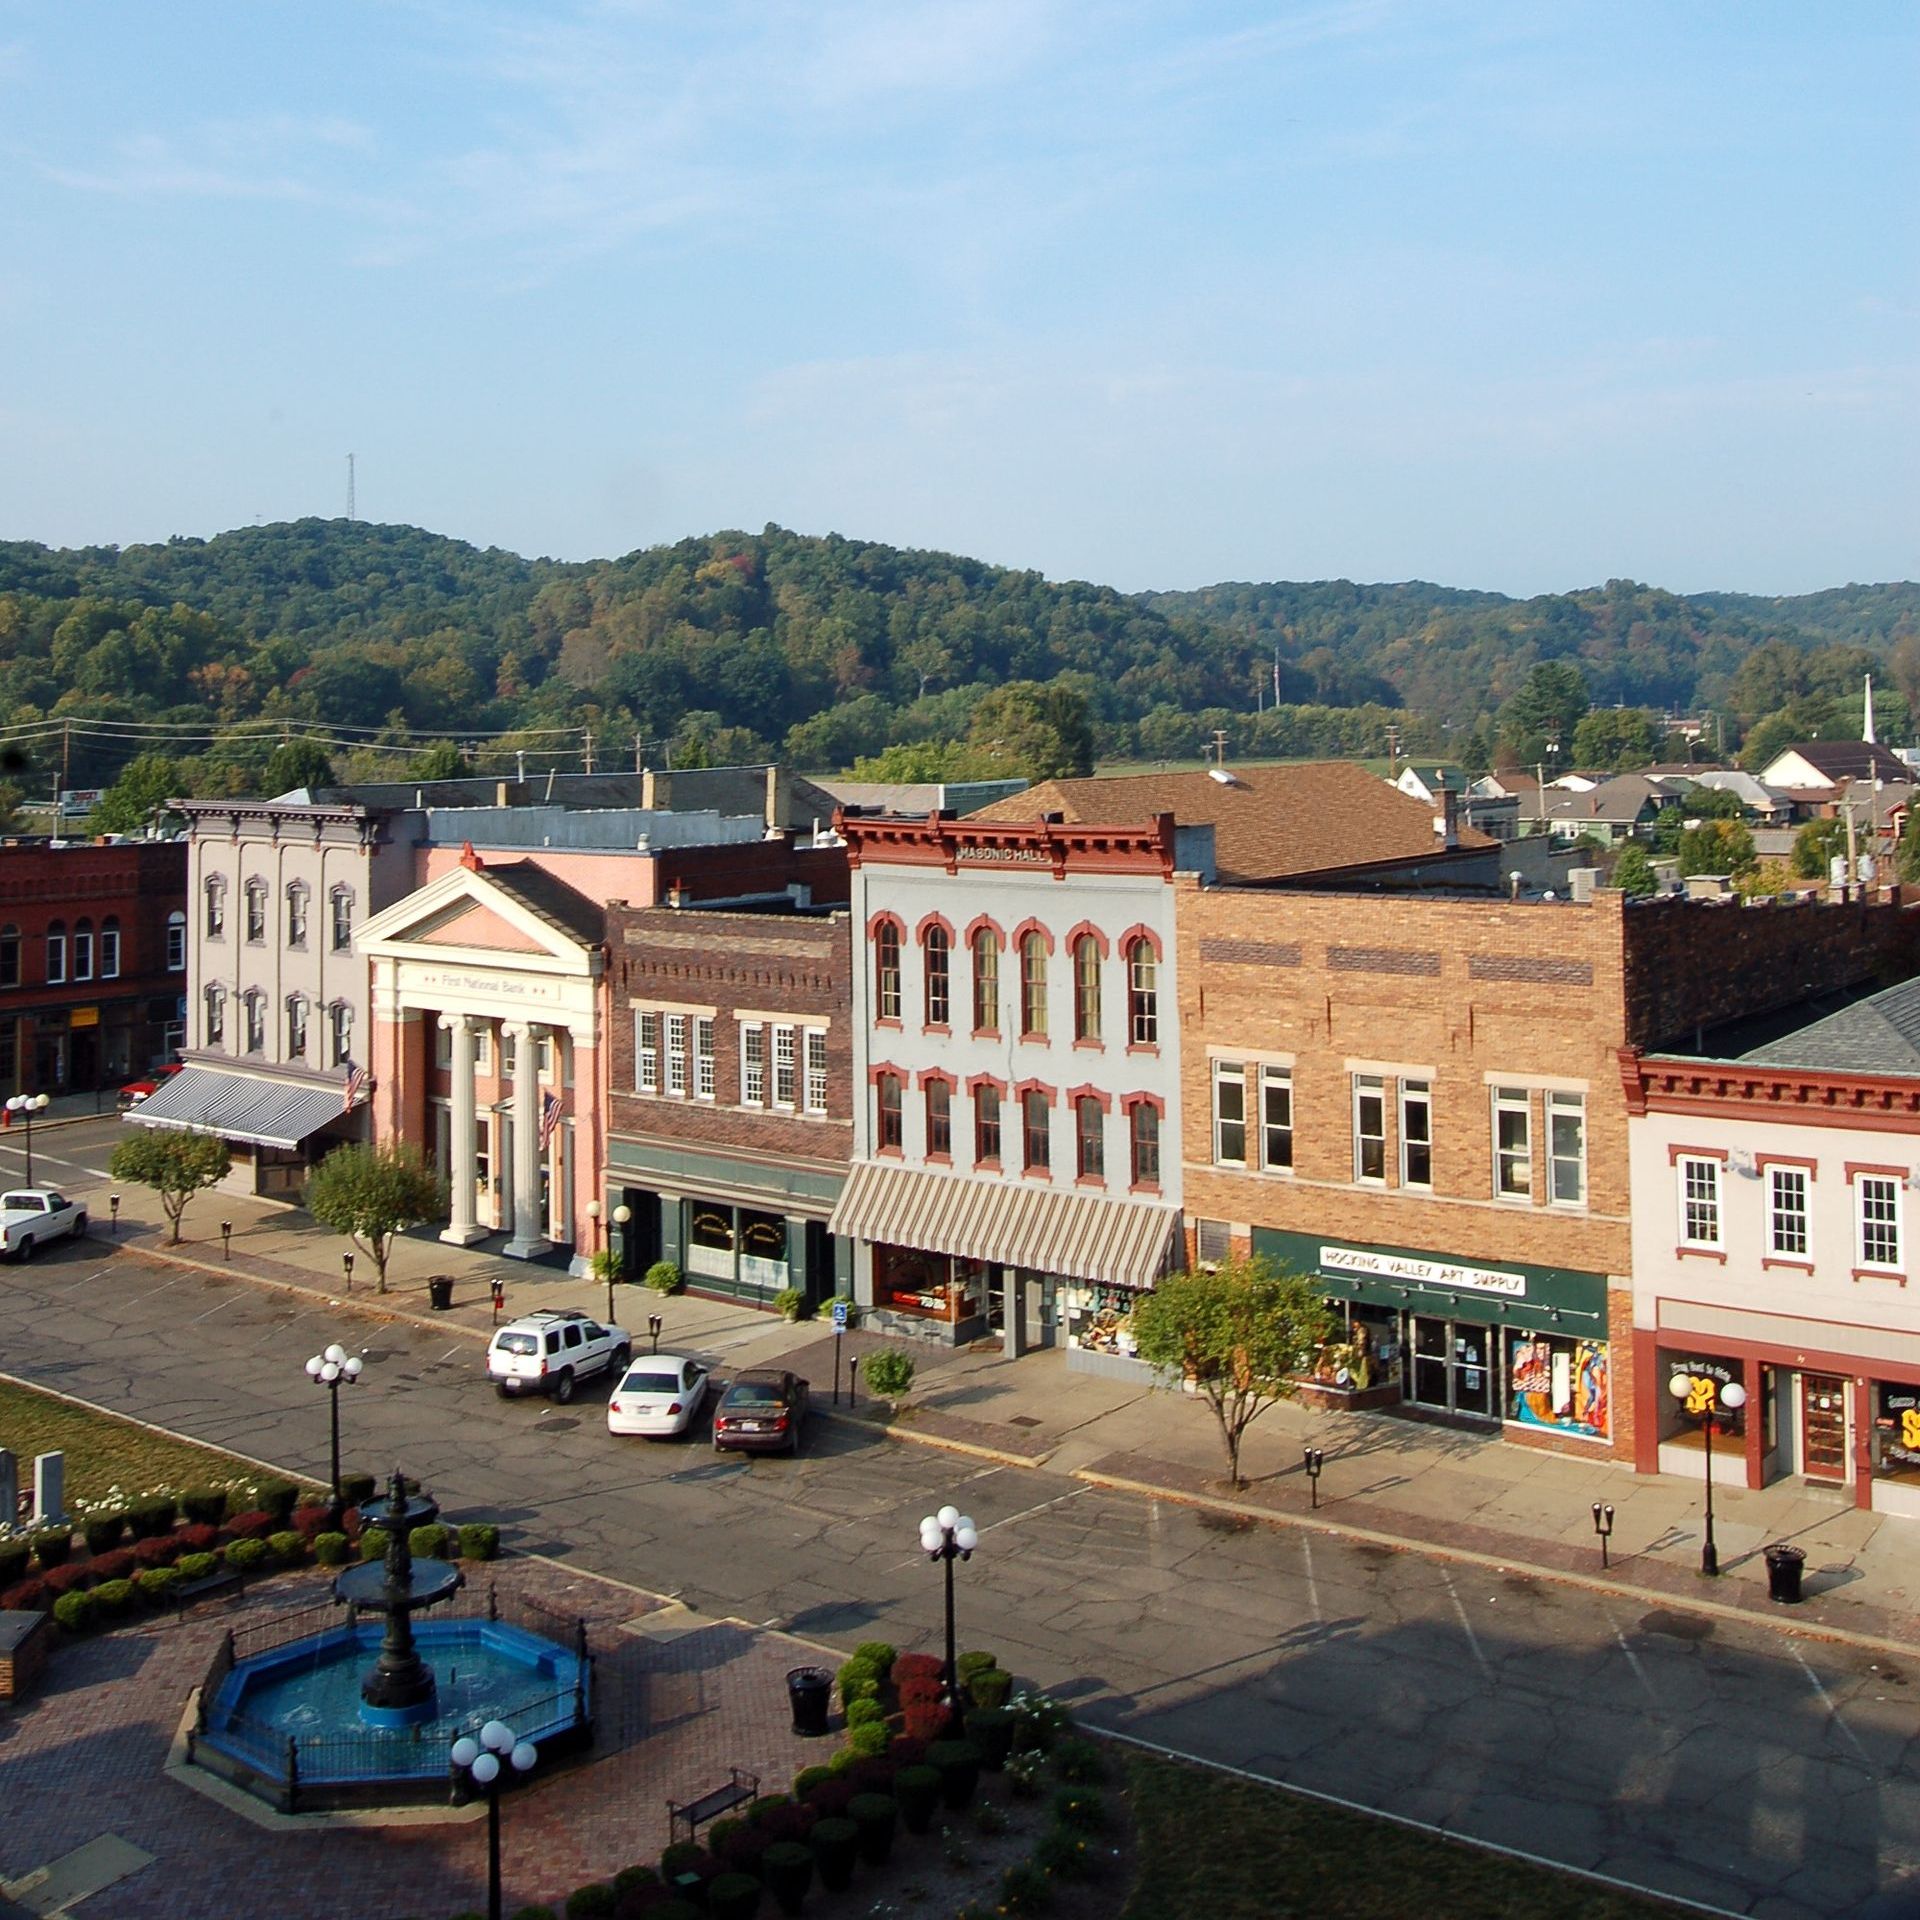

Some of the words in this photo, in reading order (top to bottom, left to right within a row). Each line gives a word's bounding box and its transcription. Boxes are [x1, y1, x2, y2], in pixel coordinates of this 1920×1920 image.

[958, 847, 1013, 861] MASONIC
[1014, 849, 1045, 862] HALL
[441, 974, 461, 987] First
[463, 977, 499, 991] National
[502, 981, 525, 994] Bank
[1325, 1251, 1380, 1270] HOCKING
[1389, 1260, 1432, 1277] VALLEY
[1440, 1269, 1465, 1282] ART
[1473, 1273, 1519, 1290] SUPPLY
